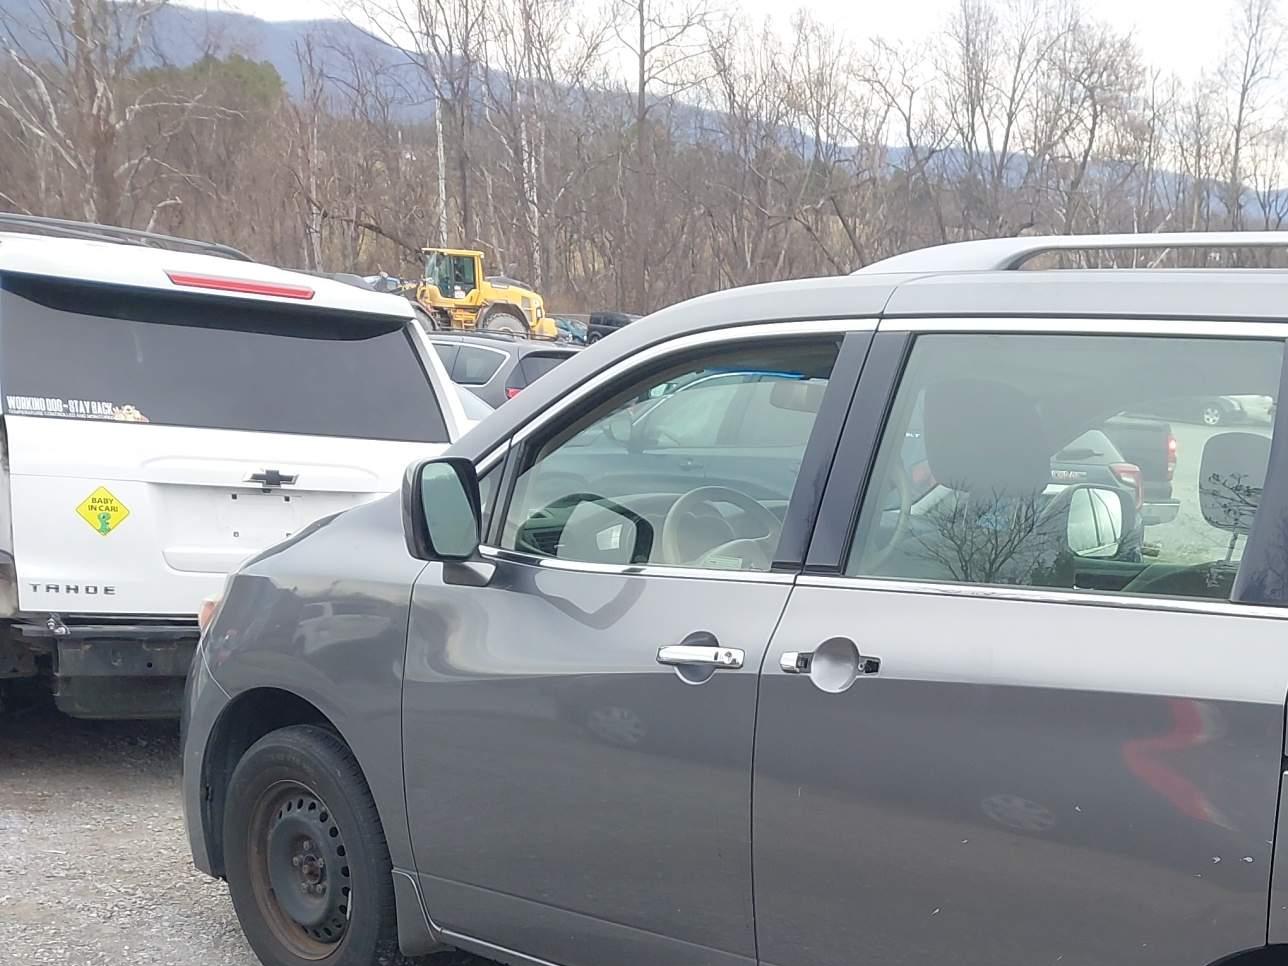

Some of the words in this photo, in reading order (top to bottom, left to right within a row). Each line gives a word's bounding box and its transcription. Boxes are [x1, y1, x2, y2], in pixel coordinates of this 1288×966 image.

[68, 399, 90, 413] STAY
[91, 401, 113, 415] BACK
[29, 583, 117, 595] TAHOE
